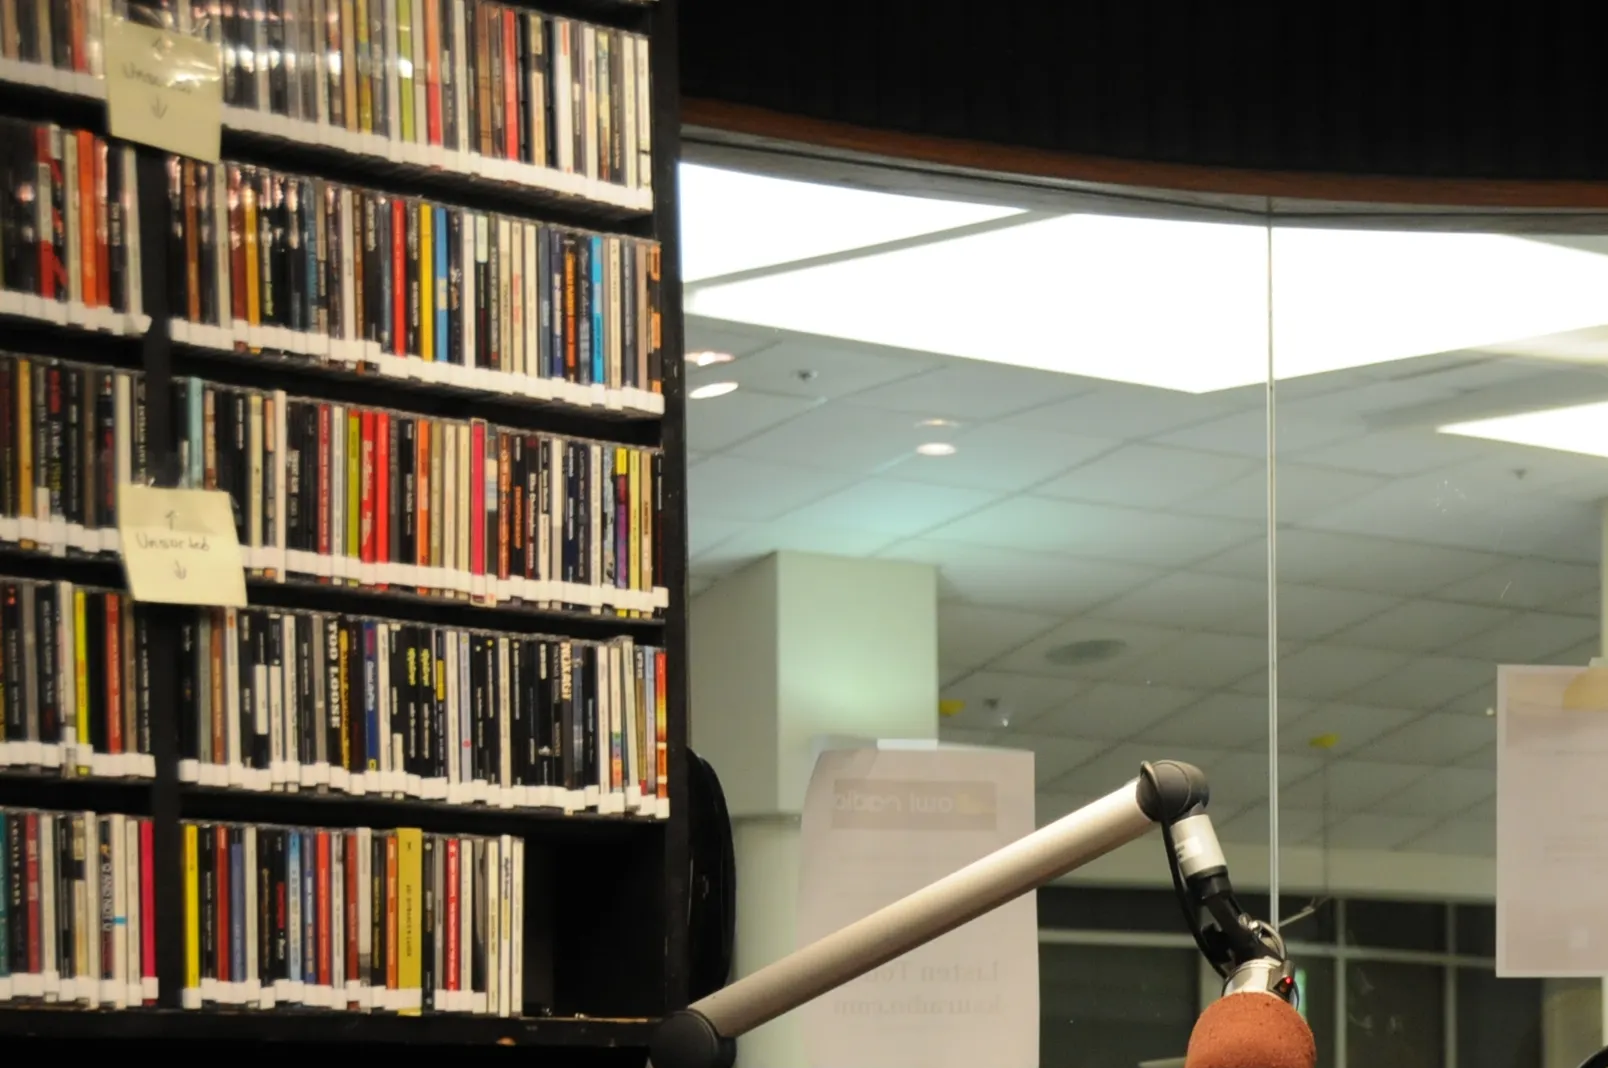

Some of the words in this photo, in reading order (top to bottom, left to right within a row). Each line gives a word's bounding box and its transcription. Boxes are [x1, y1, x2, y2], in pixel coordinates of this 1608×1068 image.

[328, 620, 339, 660] TOO
[561, 642, 573, 699] NOXAGT
[329, 665, 341, 727] LOOSE
[13, 873, 21, 906] PARK
